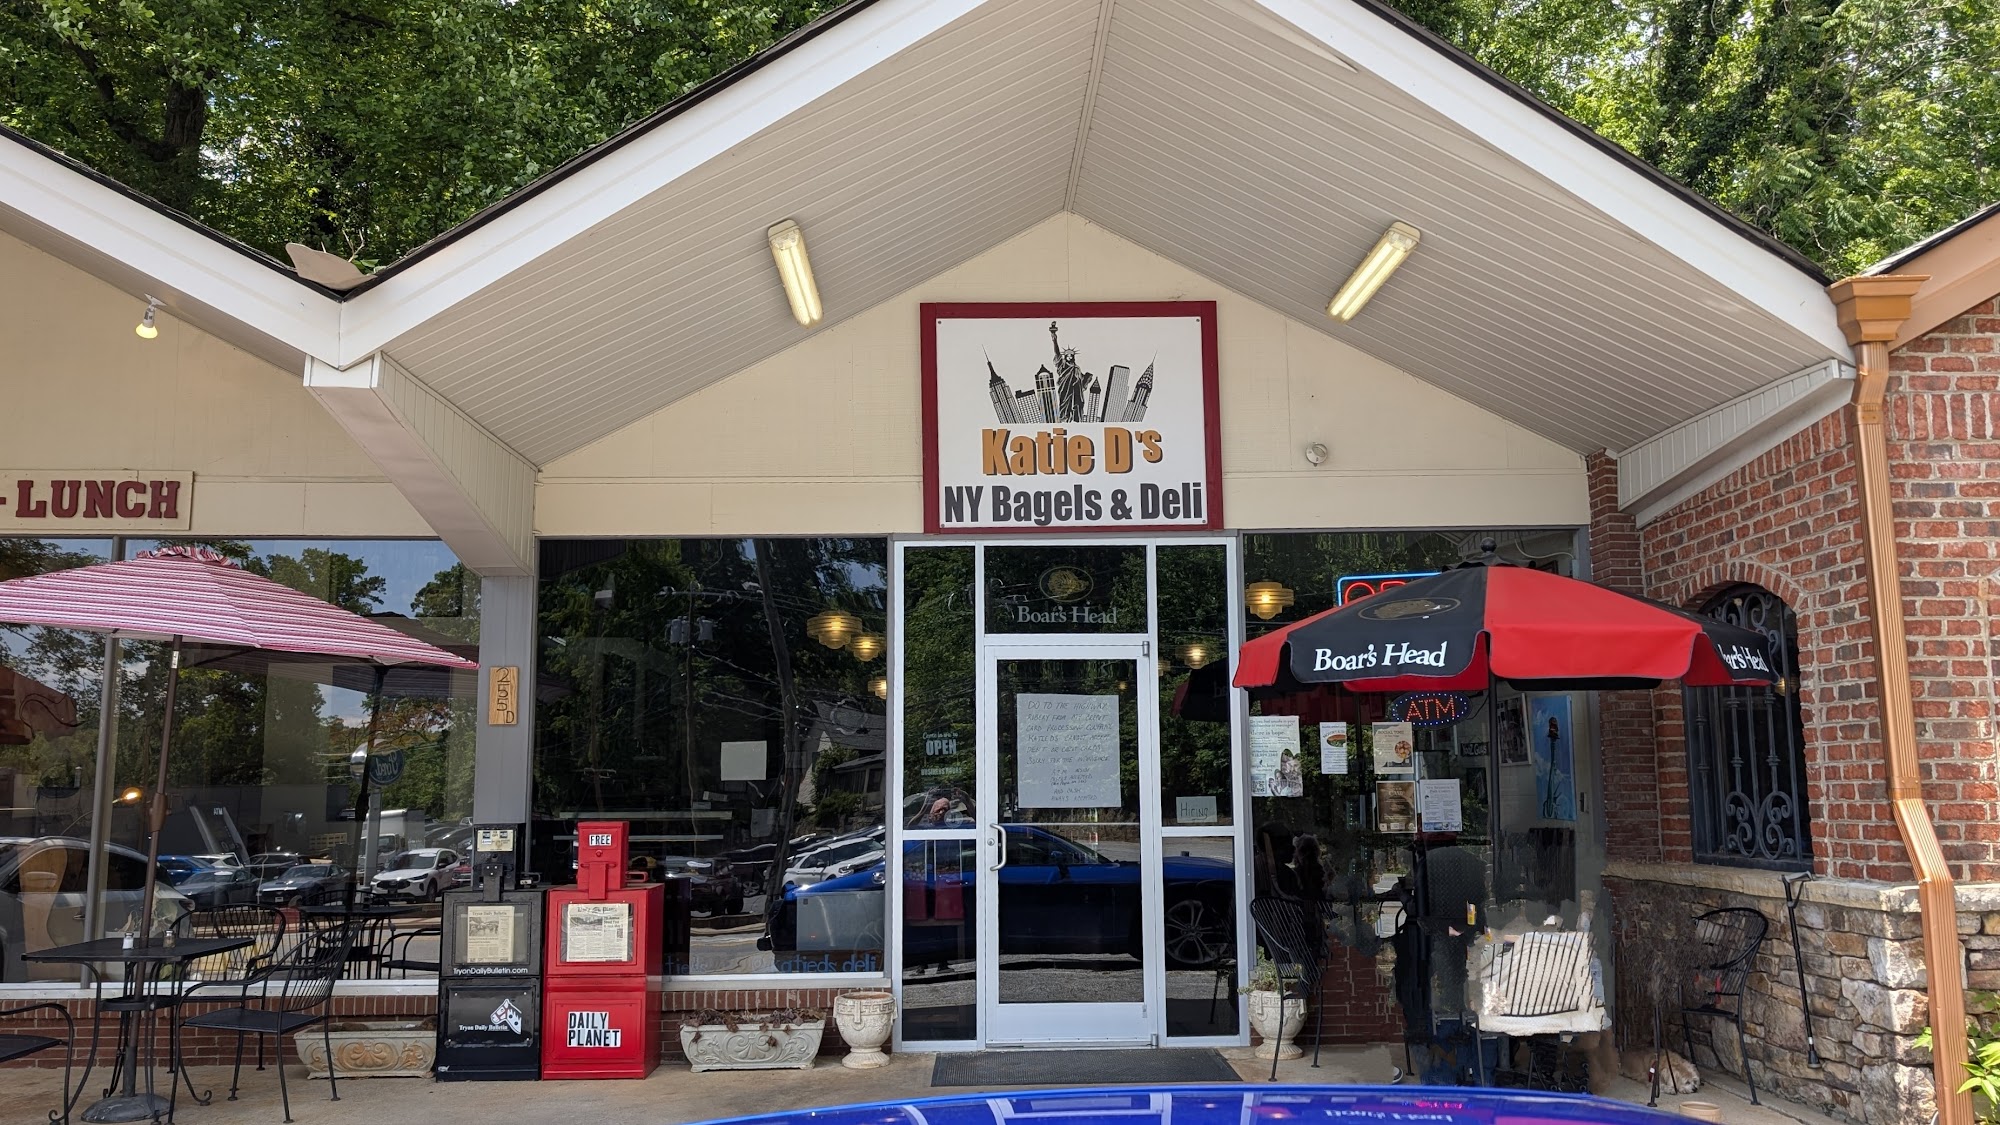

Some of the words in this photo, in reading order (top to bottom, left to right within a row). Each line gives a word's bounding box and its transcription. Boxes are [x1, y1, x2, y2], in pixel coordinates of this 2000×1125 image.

[982, 428, 1095, 476] Katie
[1104, 427, 1163, 474] D's
[944, 486, 984, 523] NY
[992, 484, 1102, 526] Bagels
[1110, 489, 1132, 520] &
[1140, 482, 1203, 520] Deli
[1017, 605, 1067, 623] Boar's
[1071, 605, 1118, 624] Head
[1313, 643, 1378, 672] Boar's
[1381, 640, 1449, 669] Head
[1717, 644, 1747, 670] oar's
[1406, 697, 1456, 722] ATM
[925, 739, 957, 756] OPEN
[590, 834, 611, 846] FREE
[453, 967, 528, 977] TryonDailyBulletin.com
[842, 952, 877, 973] deli
[475, 1024, 488, 1032] Daily
[569, 1012, 607, 1029] DAILY
[568, 1029, 620, 1046] PLANET
